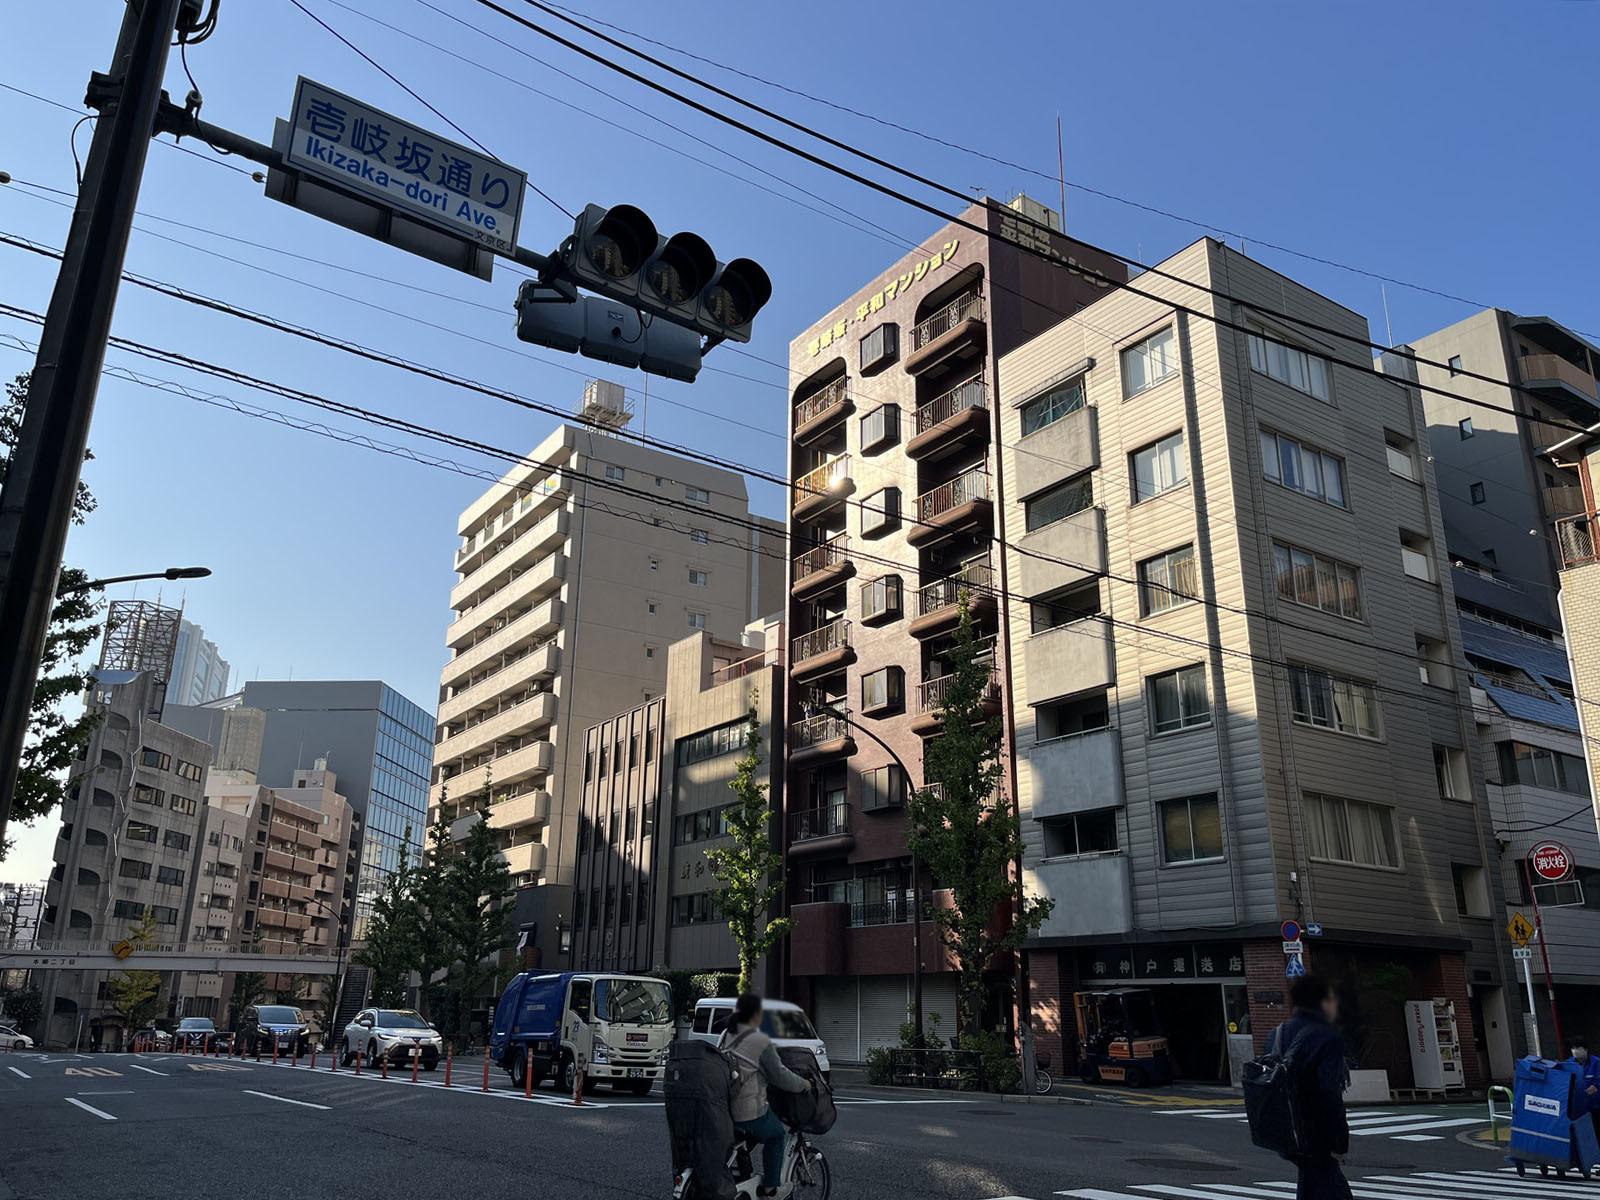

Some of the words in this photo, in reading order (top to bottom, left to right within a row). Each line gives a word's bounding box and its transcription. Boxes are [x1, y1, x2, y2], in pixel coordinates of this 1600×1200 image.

[305, 97, 510, 210] 壱岐坂通り
[305, 136, 448, 211] Ikizaka-dori
[456, 202, 501, 235] Ave.
[475, 231, 506, 250] 文京区
[1536, 855, 1566, 870] 消火栓
